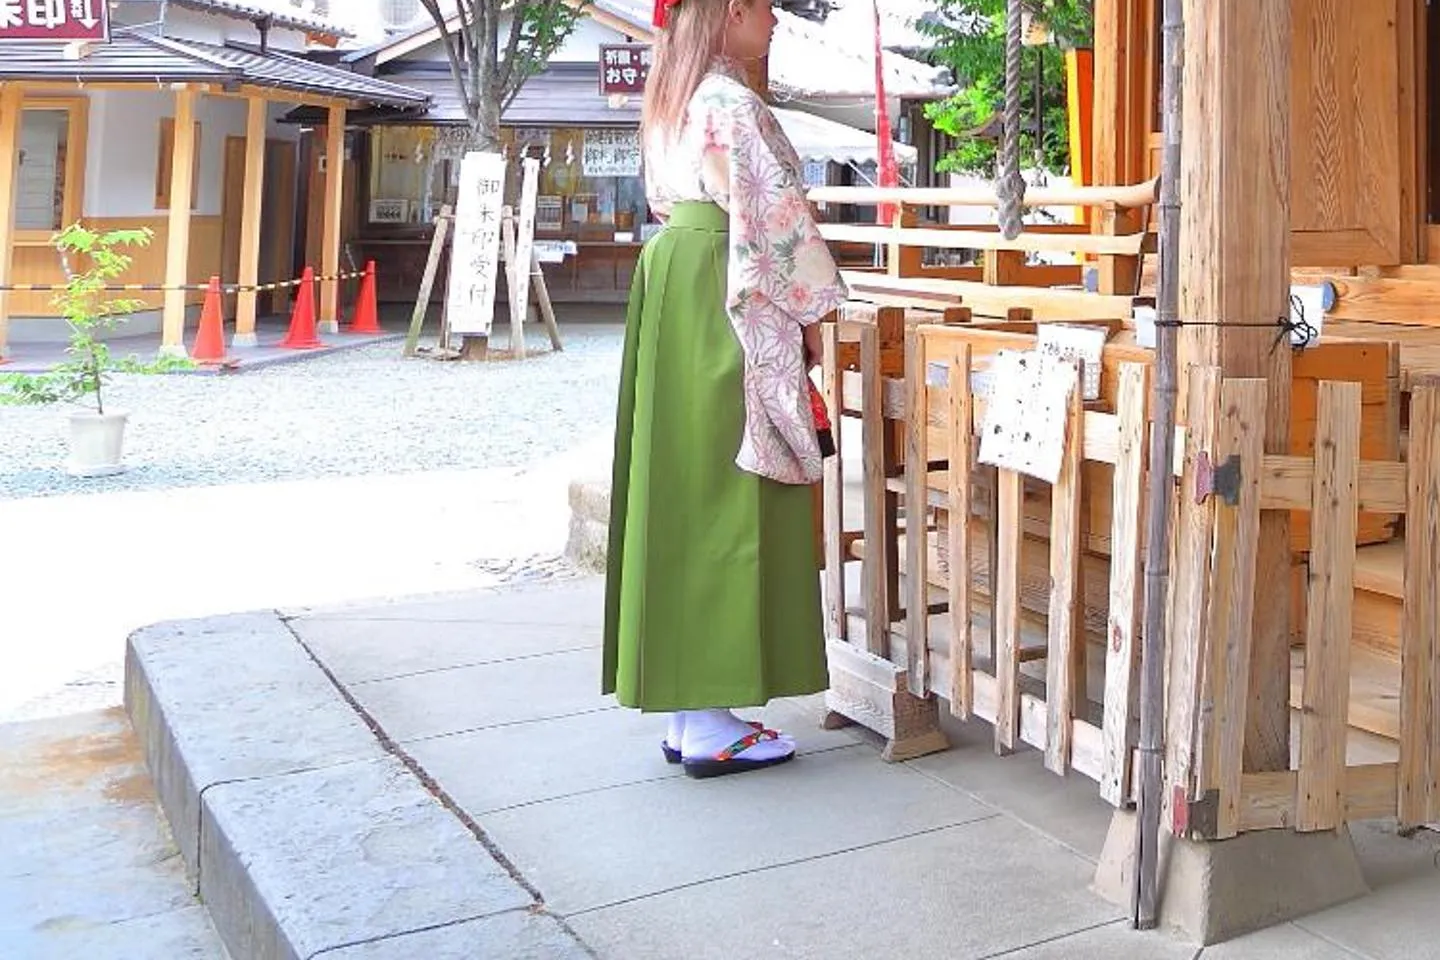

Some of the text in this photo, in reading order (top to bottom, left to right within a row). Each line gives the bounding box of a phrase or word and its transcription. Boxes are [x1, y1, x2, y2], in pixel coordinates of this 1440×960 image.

[470, 178, 500, 307] 御朱印受付
